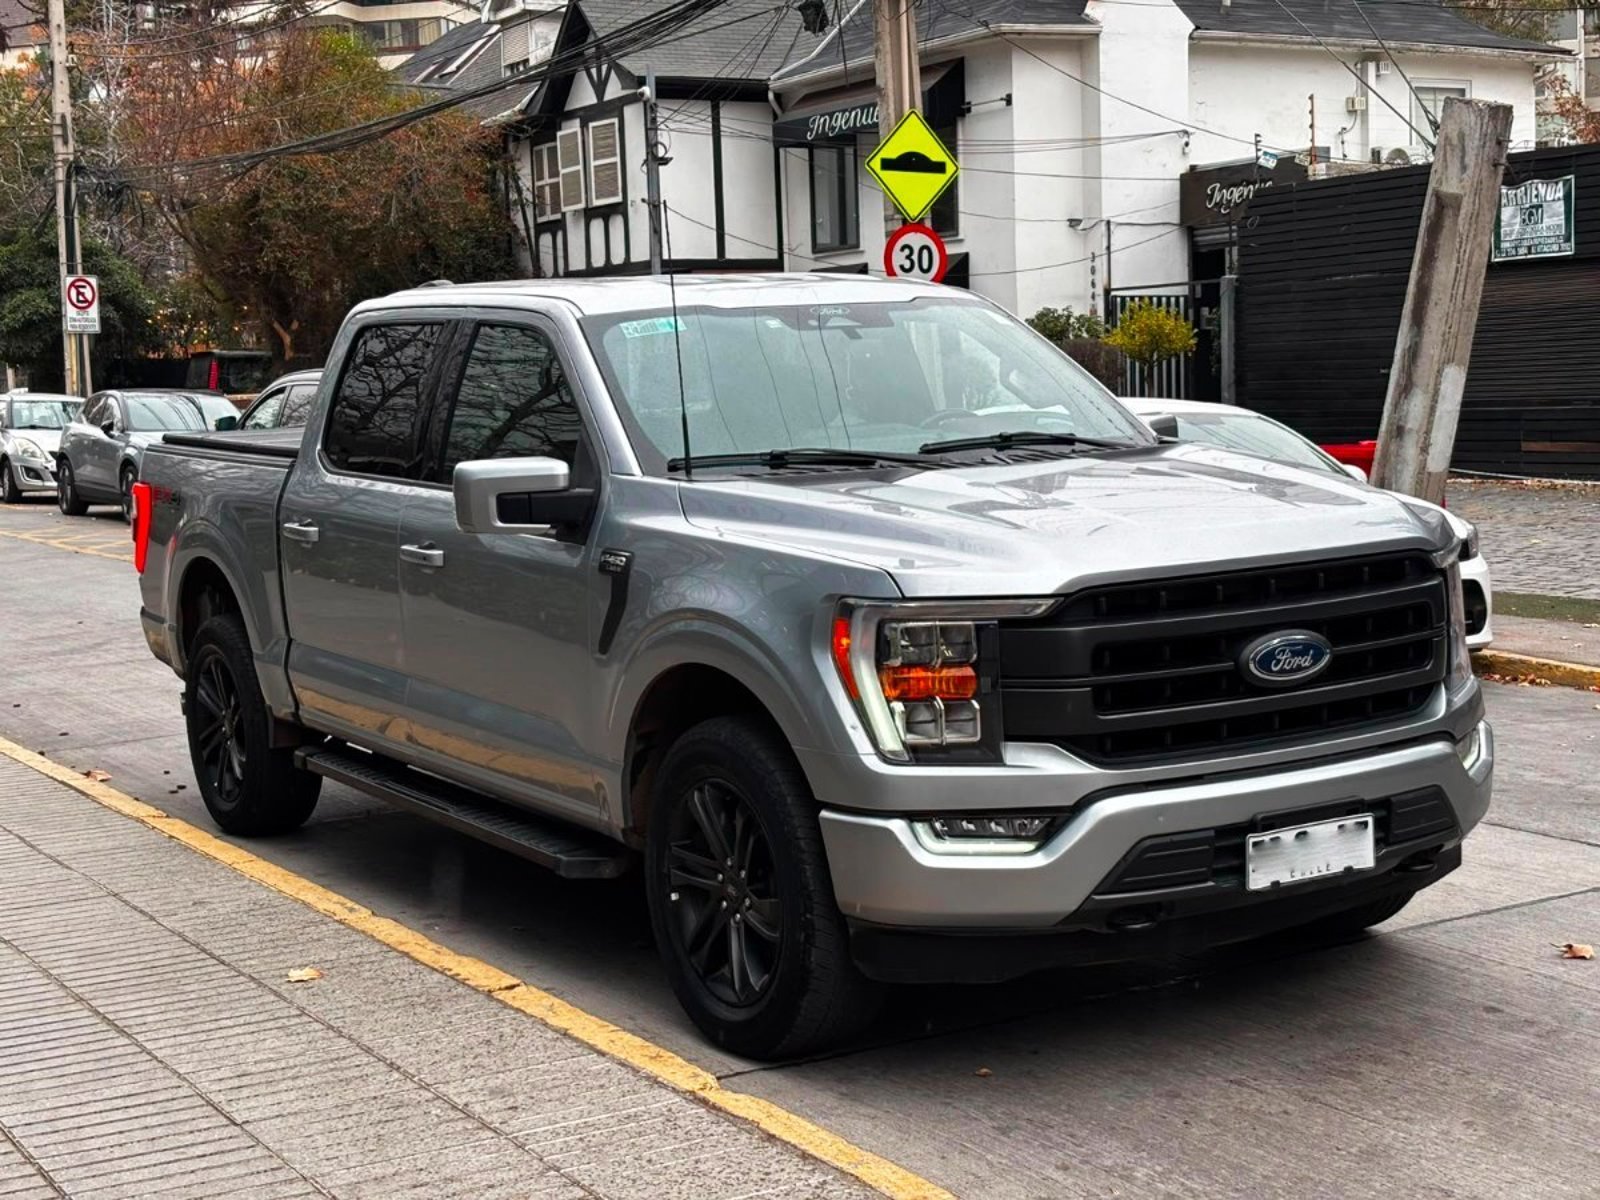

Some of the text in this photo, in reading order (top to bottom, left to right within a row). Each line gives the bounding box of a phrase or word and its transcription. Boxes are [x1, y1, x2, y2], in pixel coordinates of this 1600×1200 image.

[1501, 180, 1564, 208] ARRIENDA
[899, 243, 934, 274] 30
[75, 284, 88, 305] E
[1271, 645, 1314, 671] Ford
